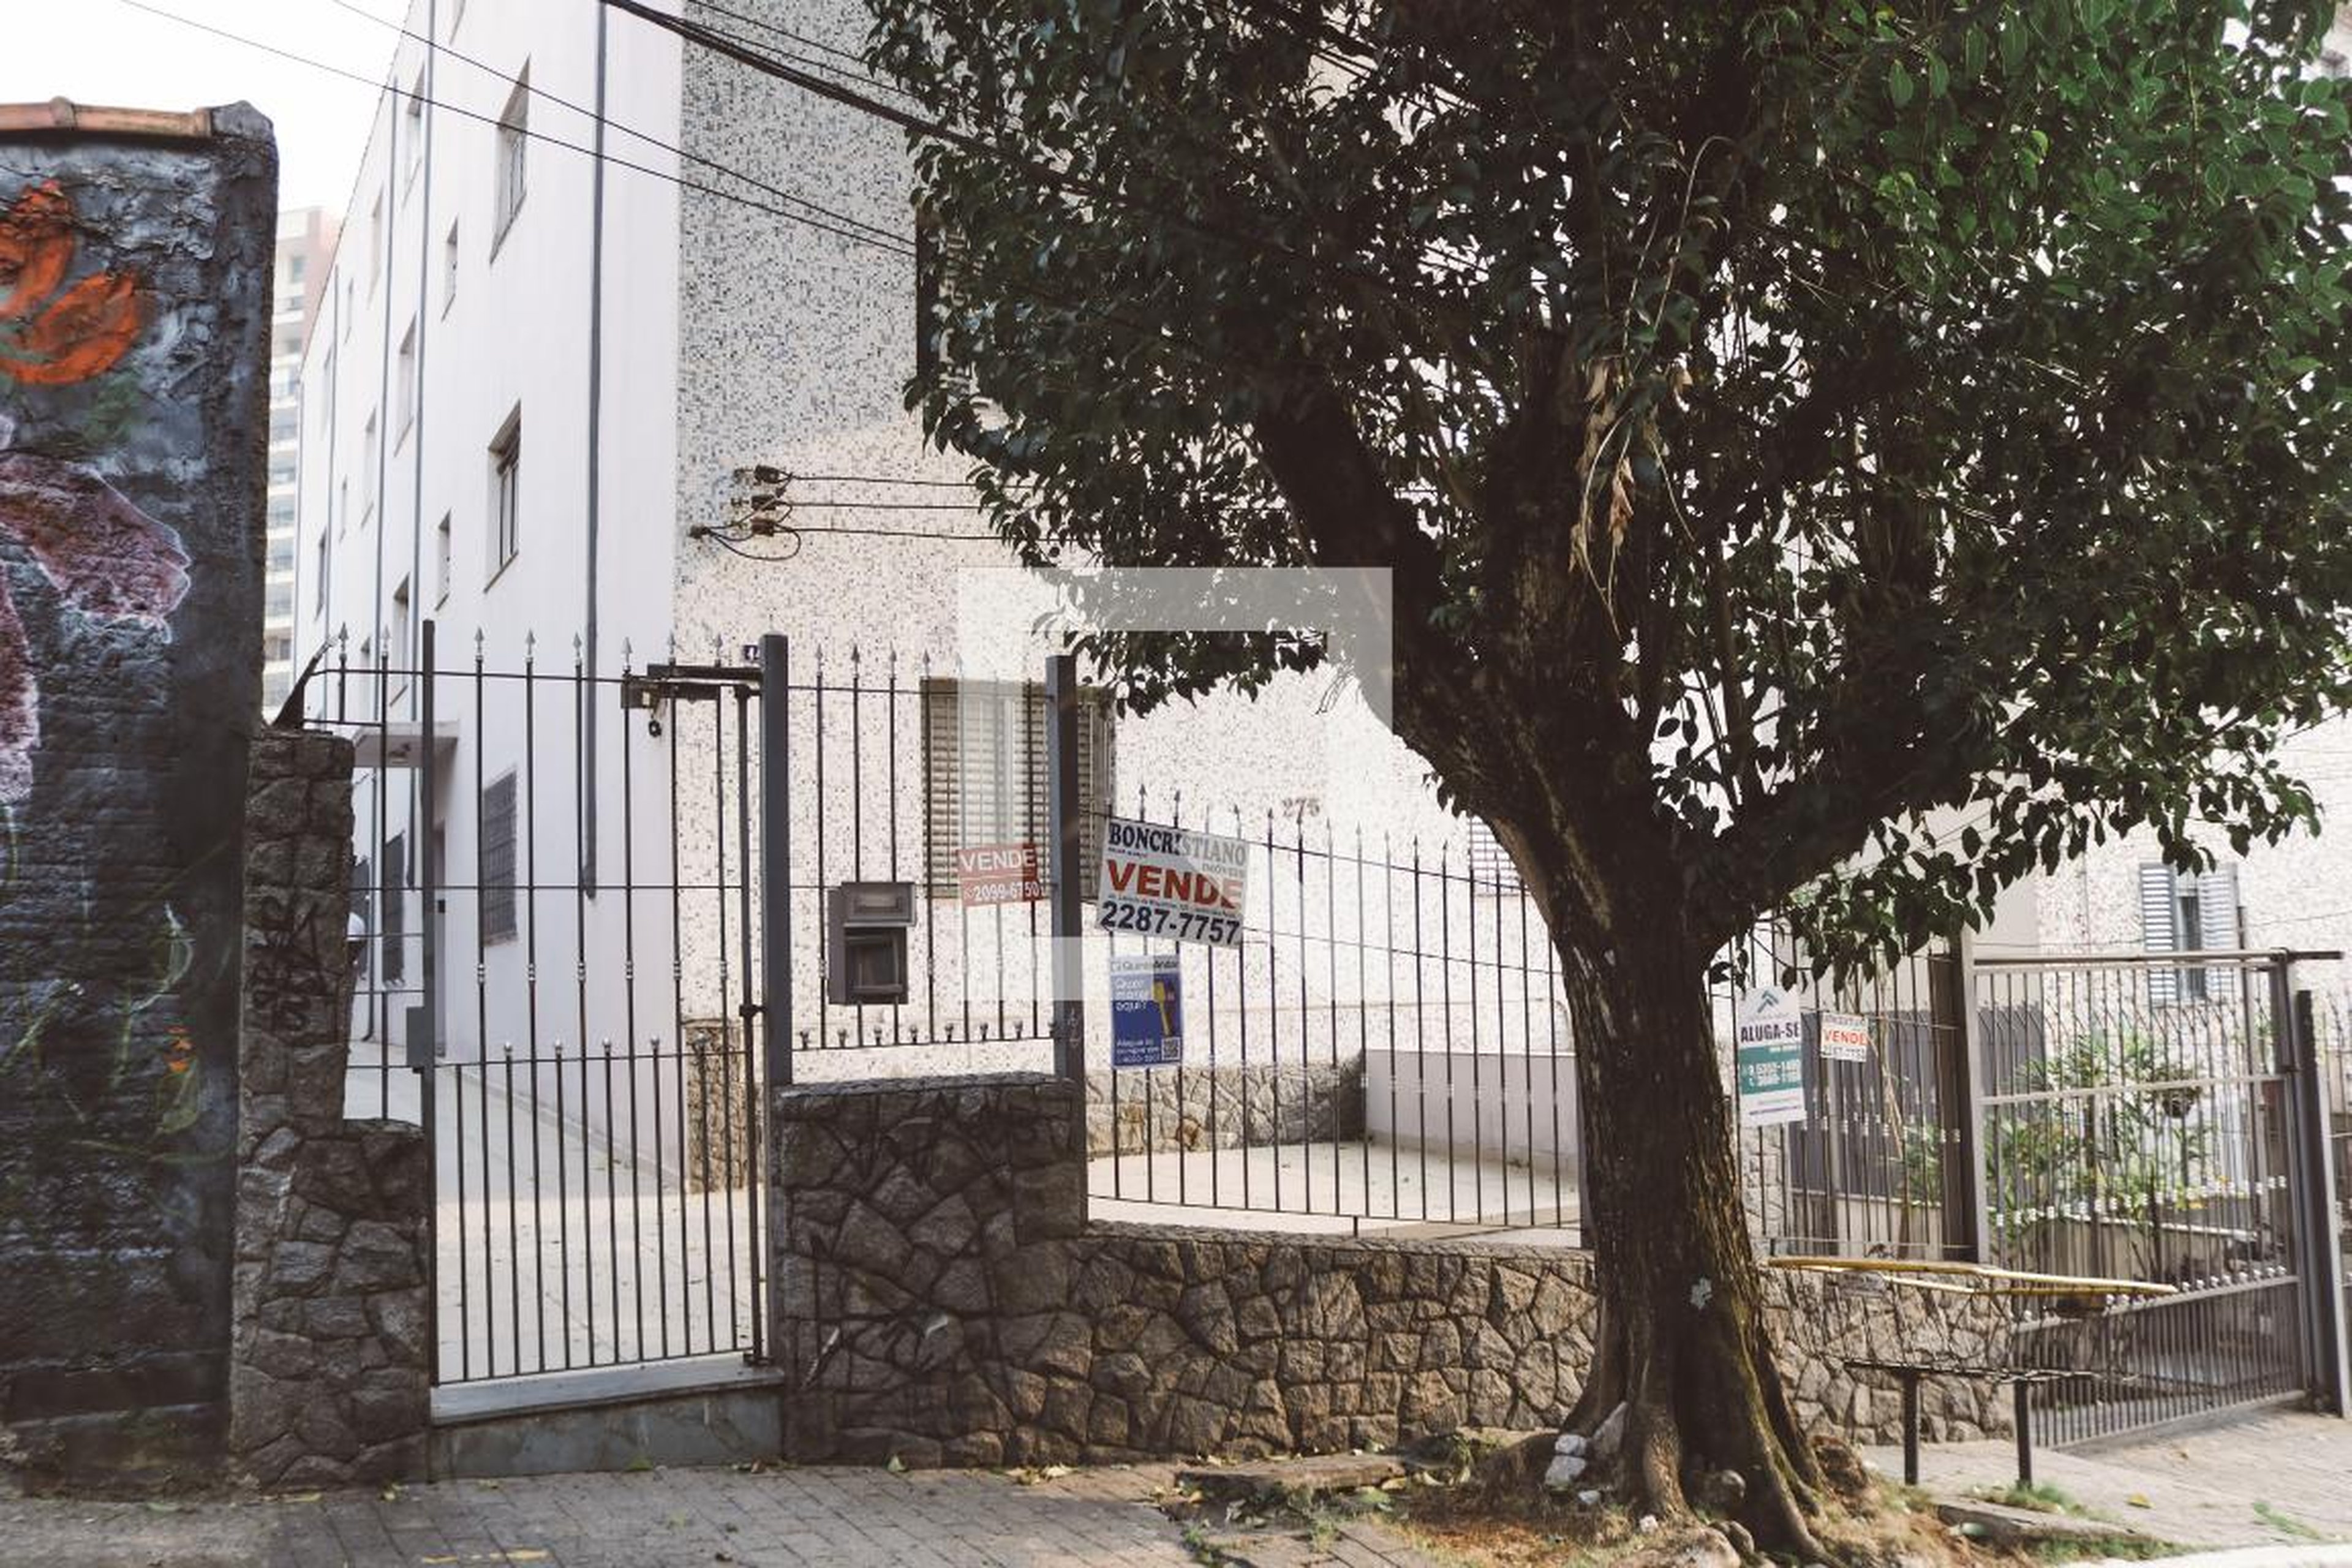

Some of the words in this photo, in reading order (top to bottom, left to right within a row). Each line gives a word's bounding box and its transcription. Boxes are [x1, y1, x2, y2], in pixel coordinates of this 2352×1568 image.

[959, 850, 1036, 872] VENDE
[1108, 822, 1246, 867] BONCRISTIANO
[1107, 859, 1243, 911] VENDE
[1102, 900, 1240, 944] 2287-7757
[1741, 1022, 1799, 1042] ALUGA-SE
